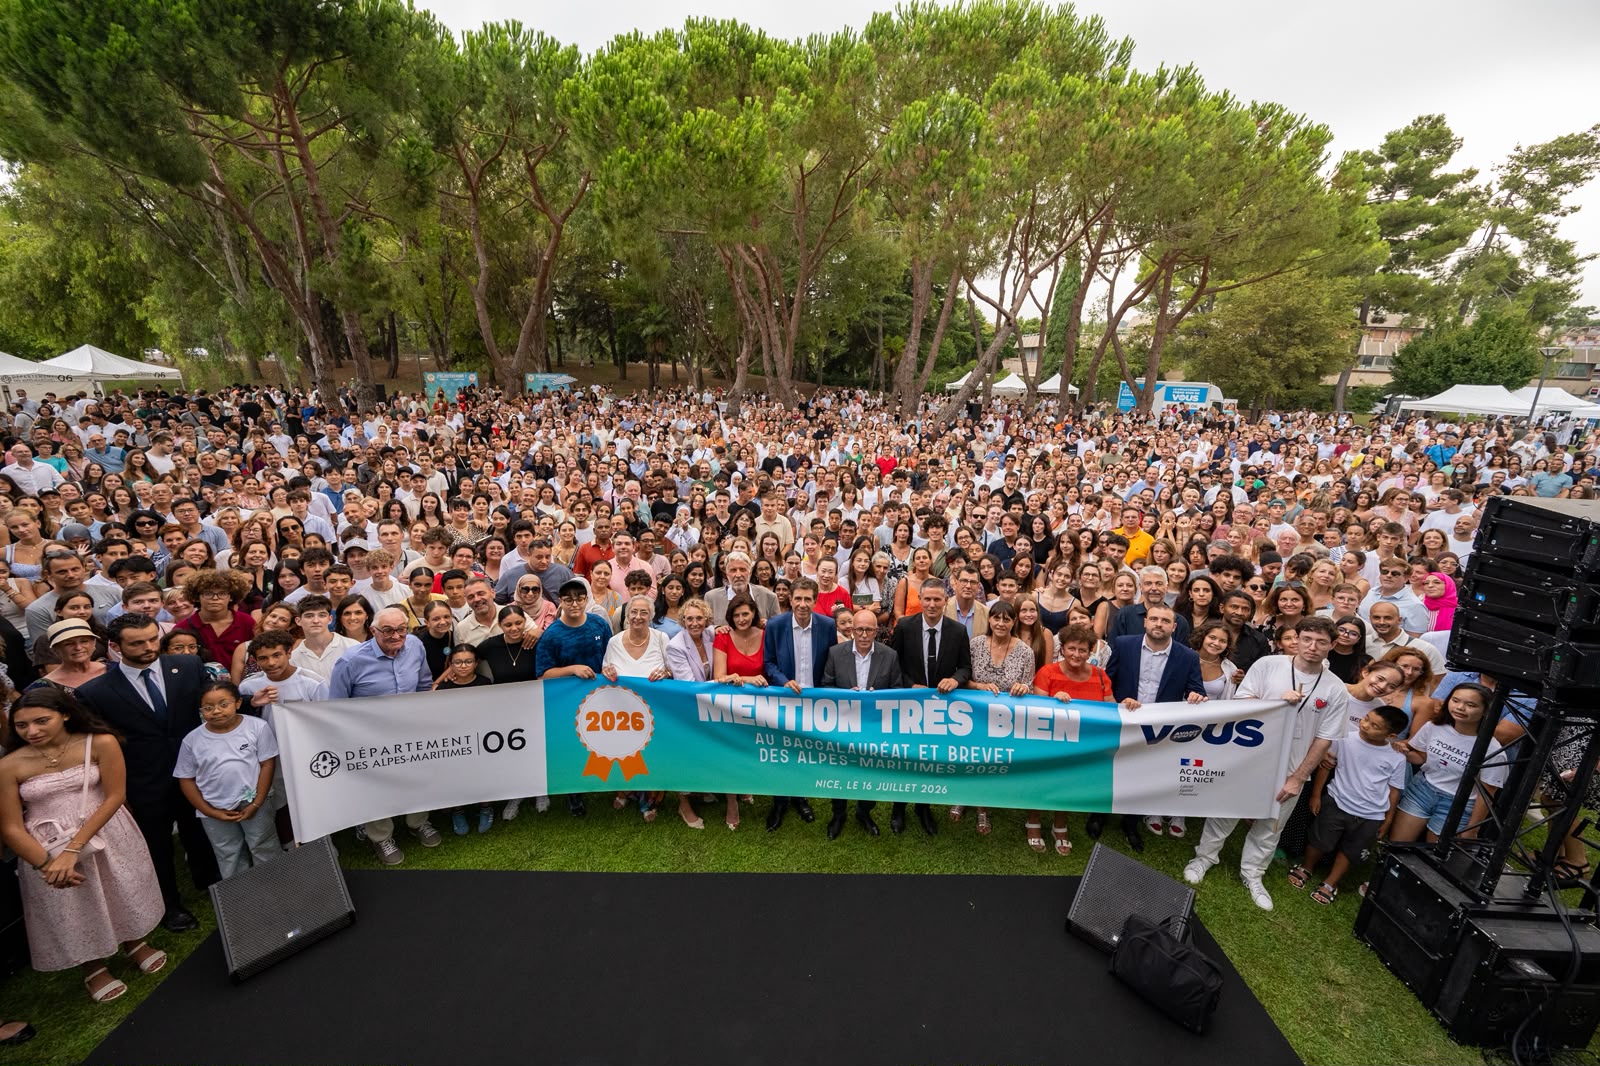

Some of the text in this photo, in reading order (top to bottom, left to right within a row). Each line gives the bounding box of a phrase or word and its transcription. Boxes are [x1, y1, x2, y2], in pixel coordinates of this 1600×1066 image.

[1172, 394, 1199, 402] VOUS
[585, 711, 645, 731] 2026
[696, 693, 1081, 743] MENTION TRÈS BIEN
[482, 728, 527, 753] 06
[1141, 719, 1265, 747] VOUS
[345, 735, 471, 761] DÉPARTEMENT
[347, 747, 472, 771] DES ALPES-MARITIMES
[755, 733, 1015, 764] AU BACCALAURÉAT ET BREVET
[1436, 740, 1471, 758] TOMMY
[759, 748, 1009, 774] DES ALPES-MARITIMES 2026
[1179, 768, 1226, 777] ACADÉMIE
[815, 780, 948, 794] NICE, LE 16 JUILLET 2026
